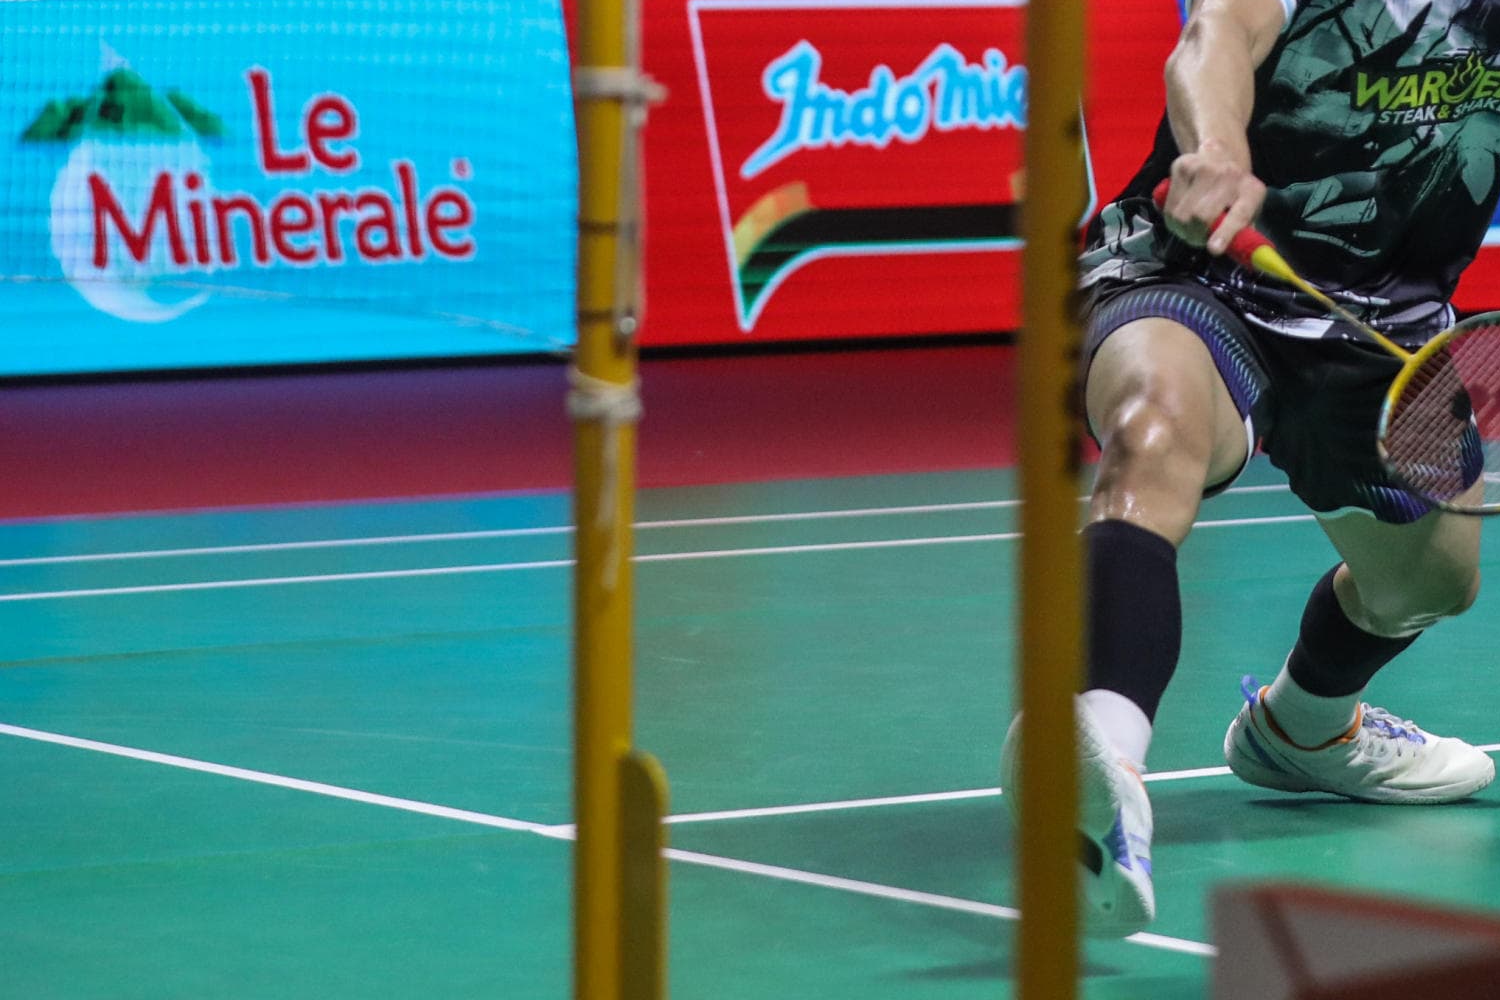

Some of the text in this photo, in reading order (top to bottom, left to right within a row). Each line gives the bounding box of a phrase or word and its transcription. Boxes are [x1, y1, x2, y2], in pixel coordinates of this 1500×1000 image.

[248, 69, 357, 172] Le
[1378, 105, 1437, 125] STEAK
[1438, 104, 1450, 120] &
